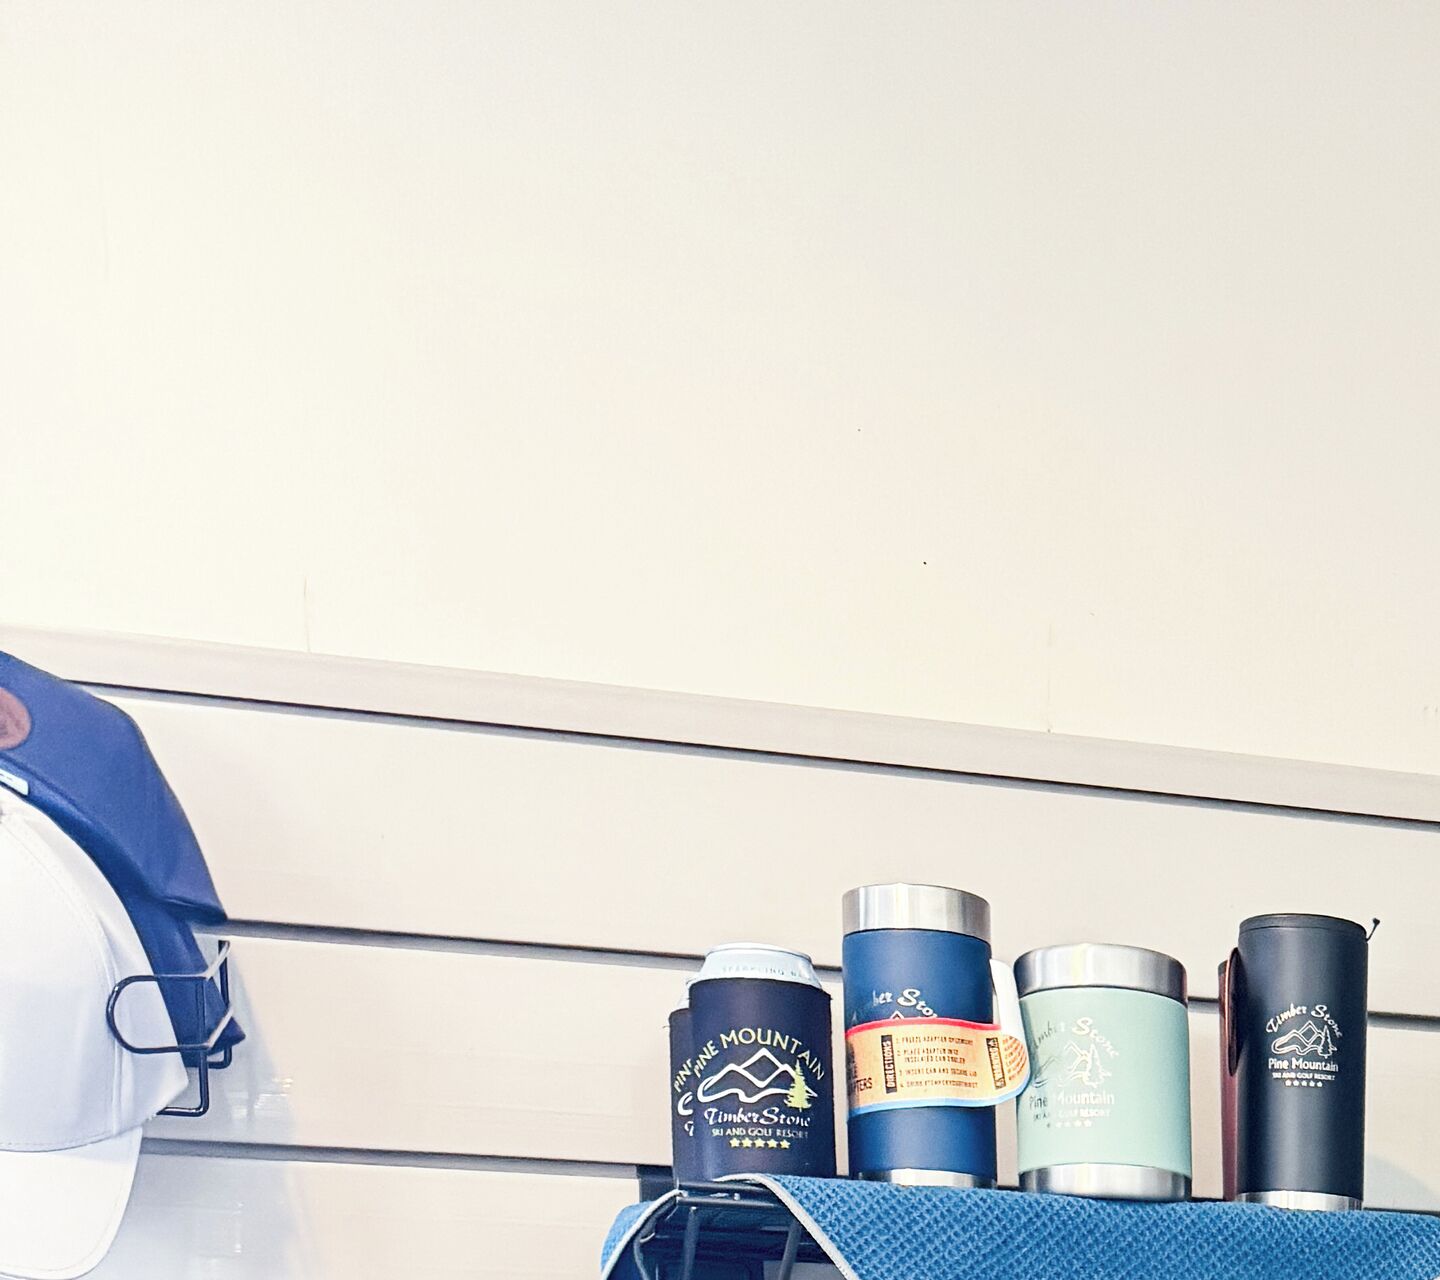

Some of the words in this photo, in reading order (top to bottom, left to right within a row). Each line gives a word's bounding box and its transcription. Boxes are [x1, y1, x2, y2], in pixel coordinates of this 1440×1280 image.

[897, 988, 938, 1018] Sto
[1265, 1002, 1308, 1033] Timber
[1310, 1004, 1343, 1039] Stone
[692, 1040, 720, 1077] PINE
[719, 1027, 826, 1082] MOUNTAIN
[882, 1039, 897, 1089] DIRECTIONS
[1268, 1057, 1290, 1070] Pine
[1291, 1057, 1339, 1072] Mountain
[725, 1128, 746, 1137] AND
[747, 1128, 772, 1138] GOLF
